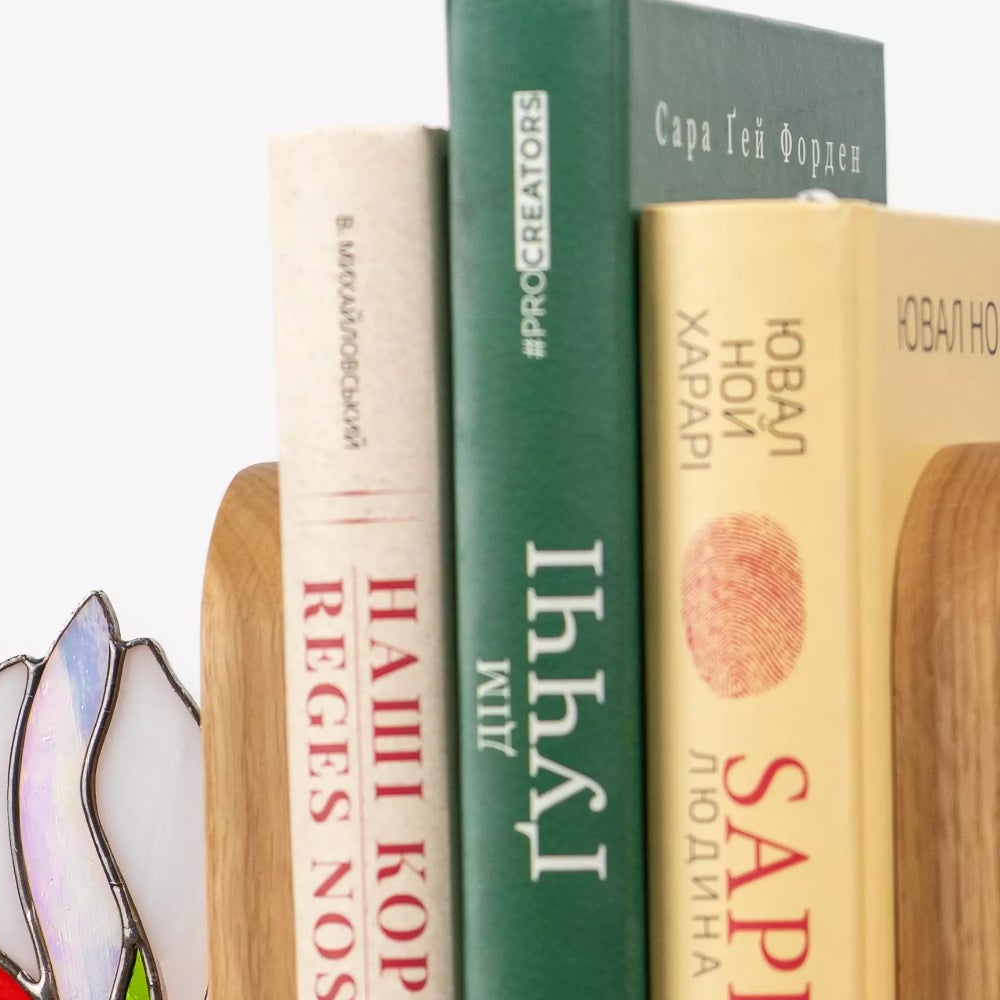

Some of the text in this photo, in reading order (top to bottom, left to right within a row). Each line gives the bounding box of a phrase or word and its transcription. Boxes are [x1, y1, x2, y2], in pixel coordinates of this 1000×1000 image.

[654, 99, 862, 178] Сара Ґей Форден
[336, 239, 368, 451] МИХАЙЛОВСЬКИЙ
[676, 308, 712, 471] ХАРАРІ
[720, 338, 767, 439] НОЙ
[766, 317, 807, 457] ЮВАЛ
[897, 295, 1000, 356] ЮВАЛ НО
[302, 579, 352, 823] REGES
[367, 575, 425, 801] НАШІ
[475, 657, 518, 757] ДІМ
[513, 539, 608, 883] ҐУЧЧІ
[685, 748, 722, 979] ЛЮДИНА
